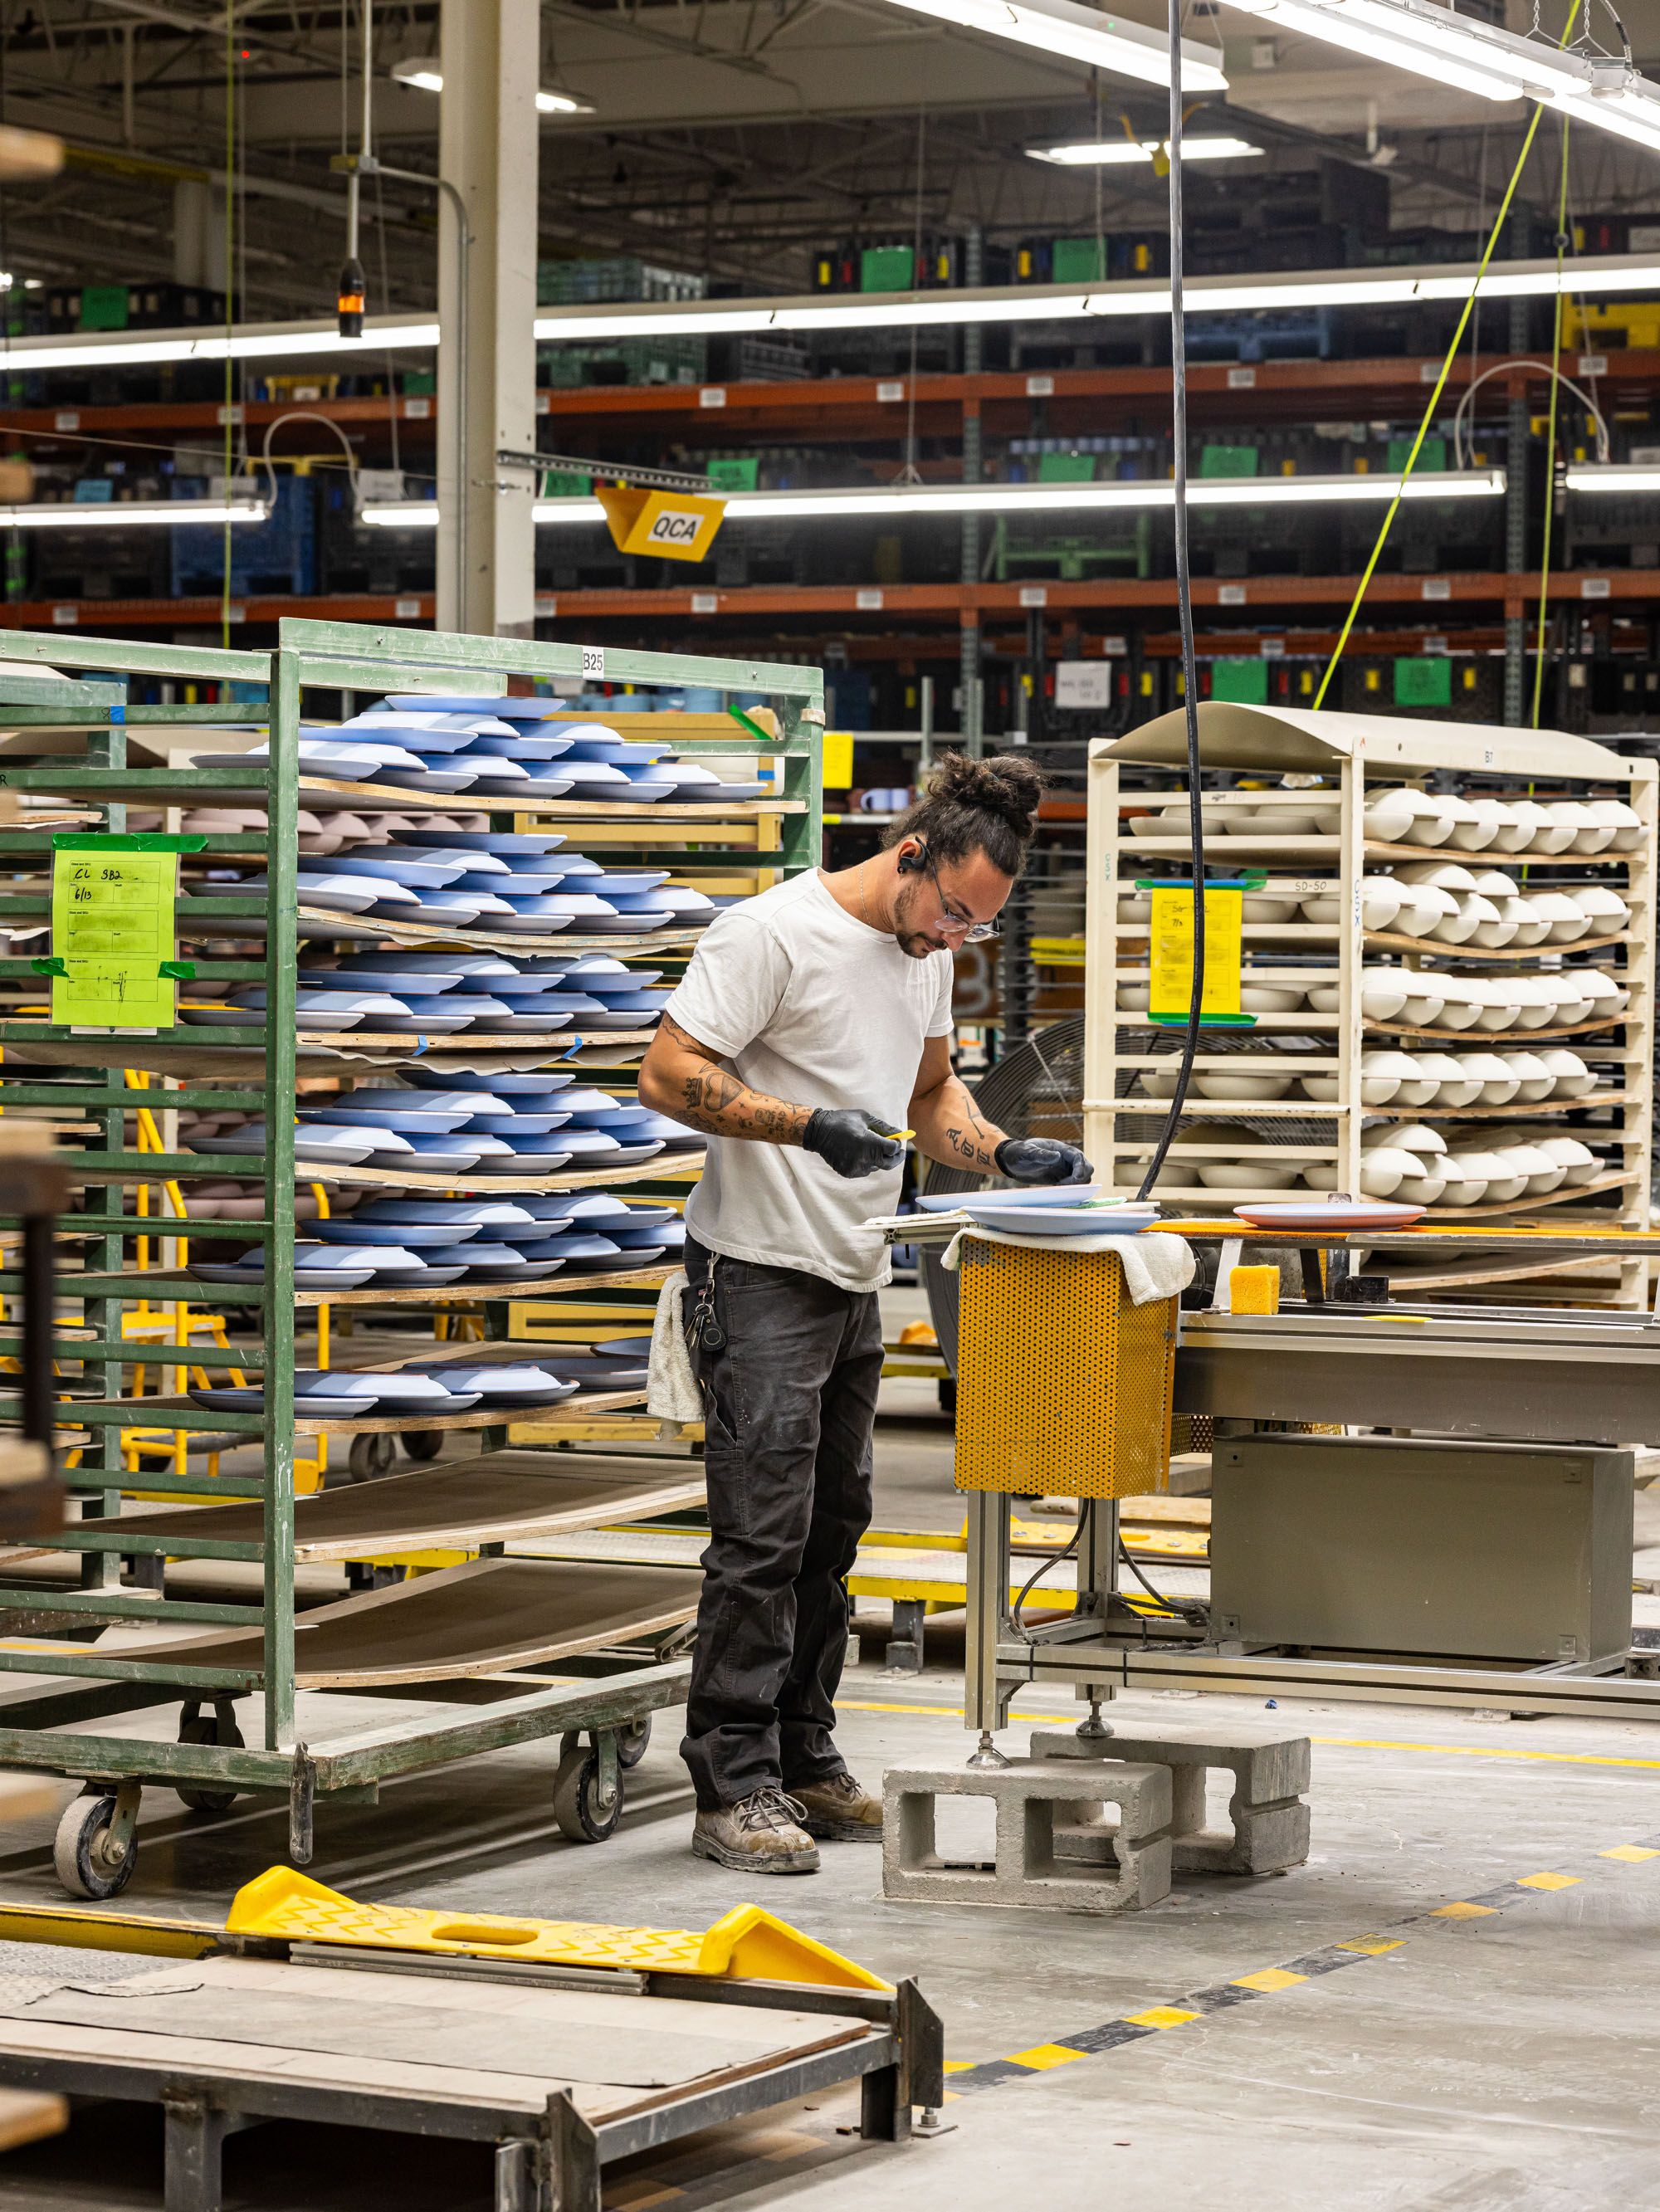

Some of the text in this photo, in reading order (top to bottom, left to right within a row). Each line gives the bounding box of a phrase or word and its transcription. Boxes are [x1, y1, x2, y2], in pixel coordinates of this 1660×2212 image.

[652, 516, 697, 540] QCA
[583, 652, 603, 671] B25
[101, 868, 124, 881] SB2
[1295, 881, 1327, 891] SD-50
[75, 887, 91, 901] 6/13
